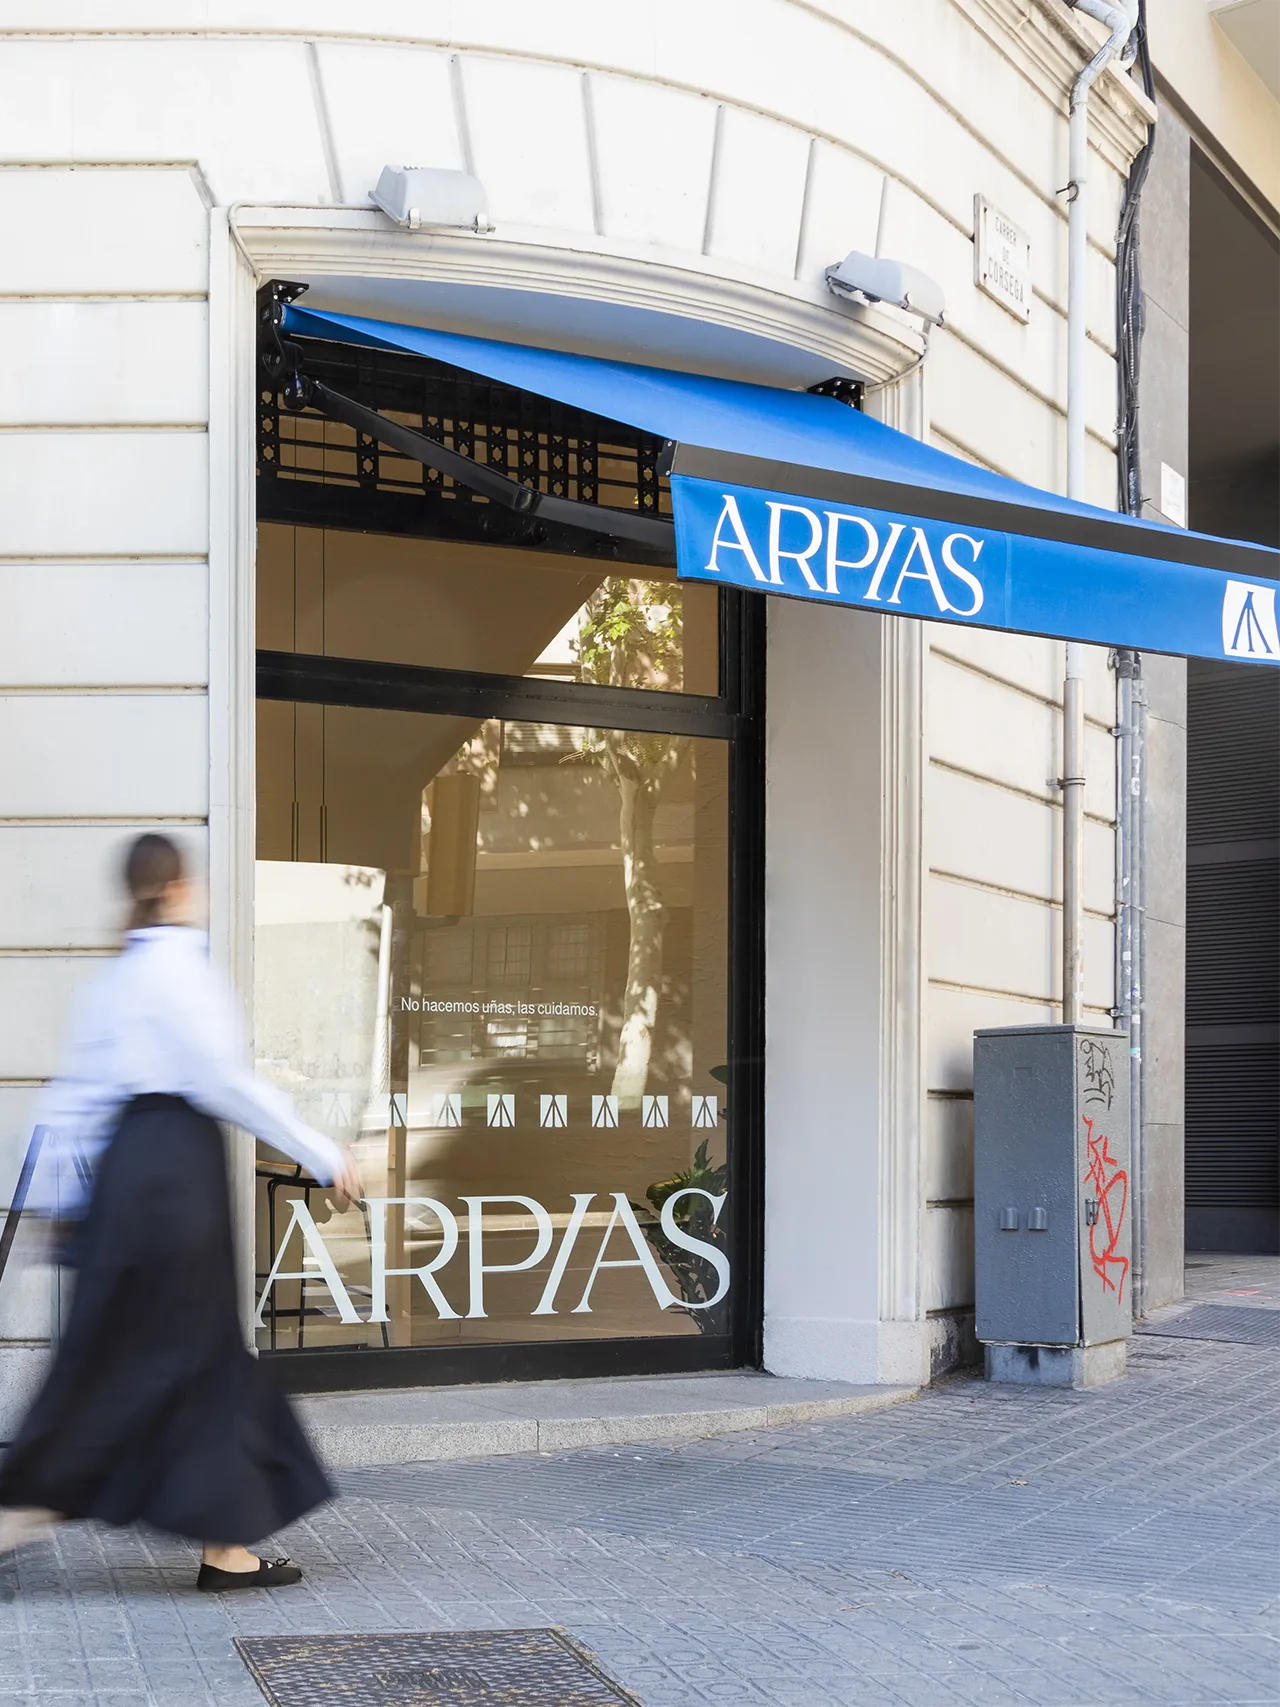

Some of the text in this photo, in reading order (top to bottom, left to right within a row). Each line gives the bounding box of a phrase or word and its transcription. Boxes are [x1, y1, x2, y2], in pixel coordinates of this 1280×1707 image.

[995, 216, 1017, 247] CARRER
[1002, 246, 1010, 265] DE
[988, 256, 1024, 304] CORSEGA
[704, 494, 985, 616] ARPIAS
[401, 997, 599, 1017] No hacemos uñas, las cuidamos.
[255, 1188, 731, 1328] ARPIAS
